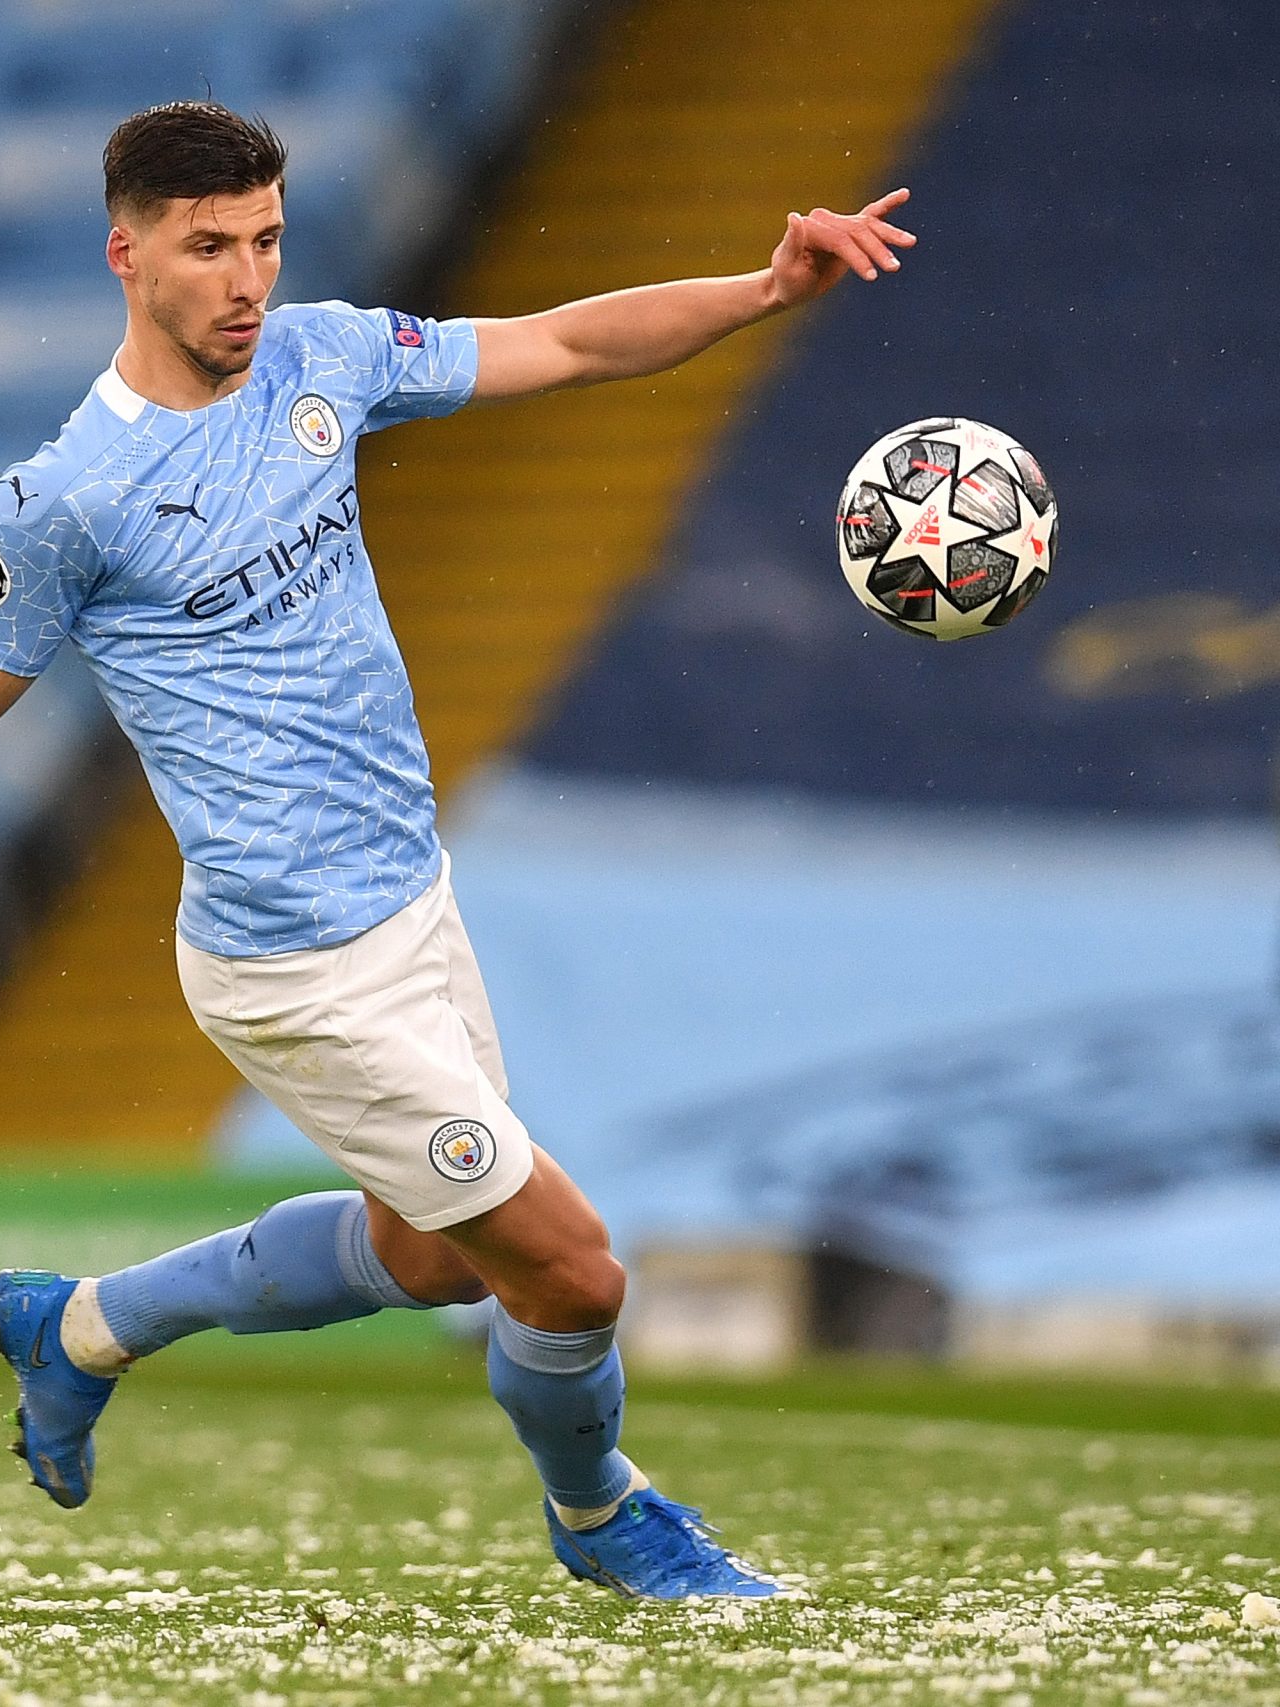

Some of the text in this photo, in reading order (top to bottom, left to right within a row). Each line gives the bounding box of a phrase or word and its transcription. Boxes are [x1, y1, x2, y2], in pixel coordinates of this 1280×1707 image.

[294, 400, 326, 429] MANCHESTER
[904, 505, 936, 545] adidas
[183, 484, 360, 620] ETIHAD
[244, 543, 355, 632] AIRWAYS
[434, 1124, 481, 1155] MANCHESTER
[467, 1166, 485, 1178] CITY
